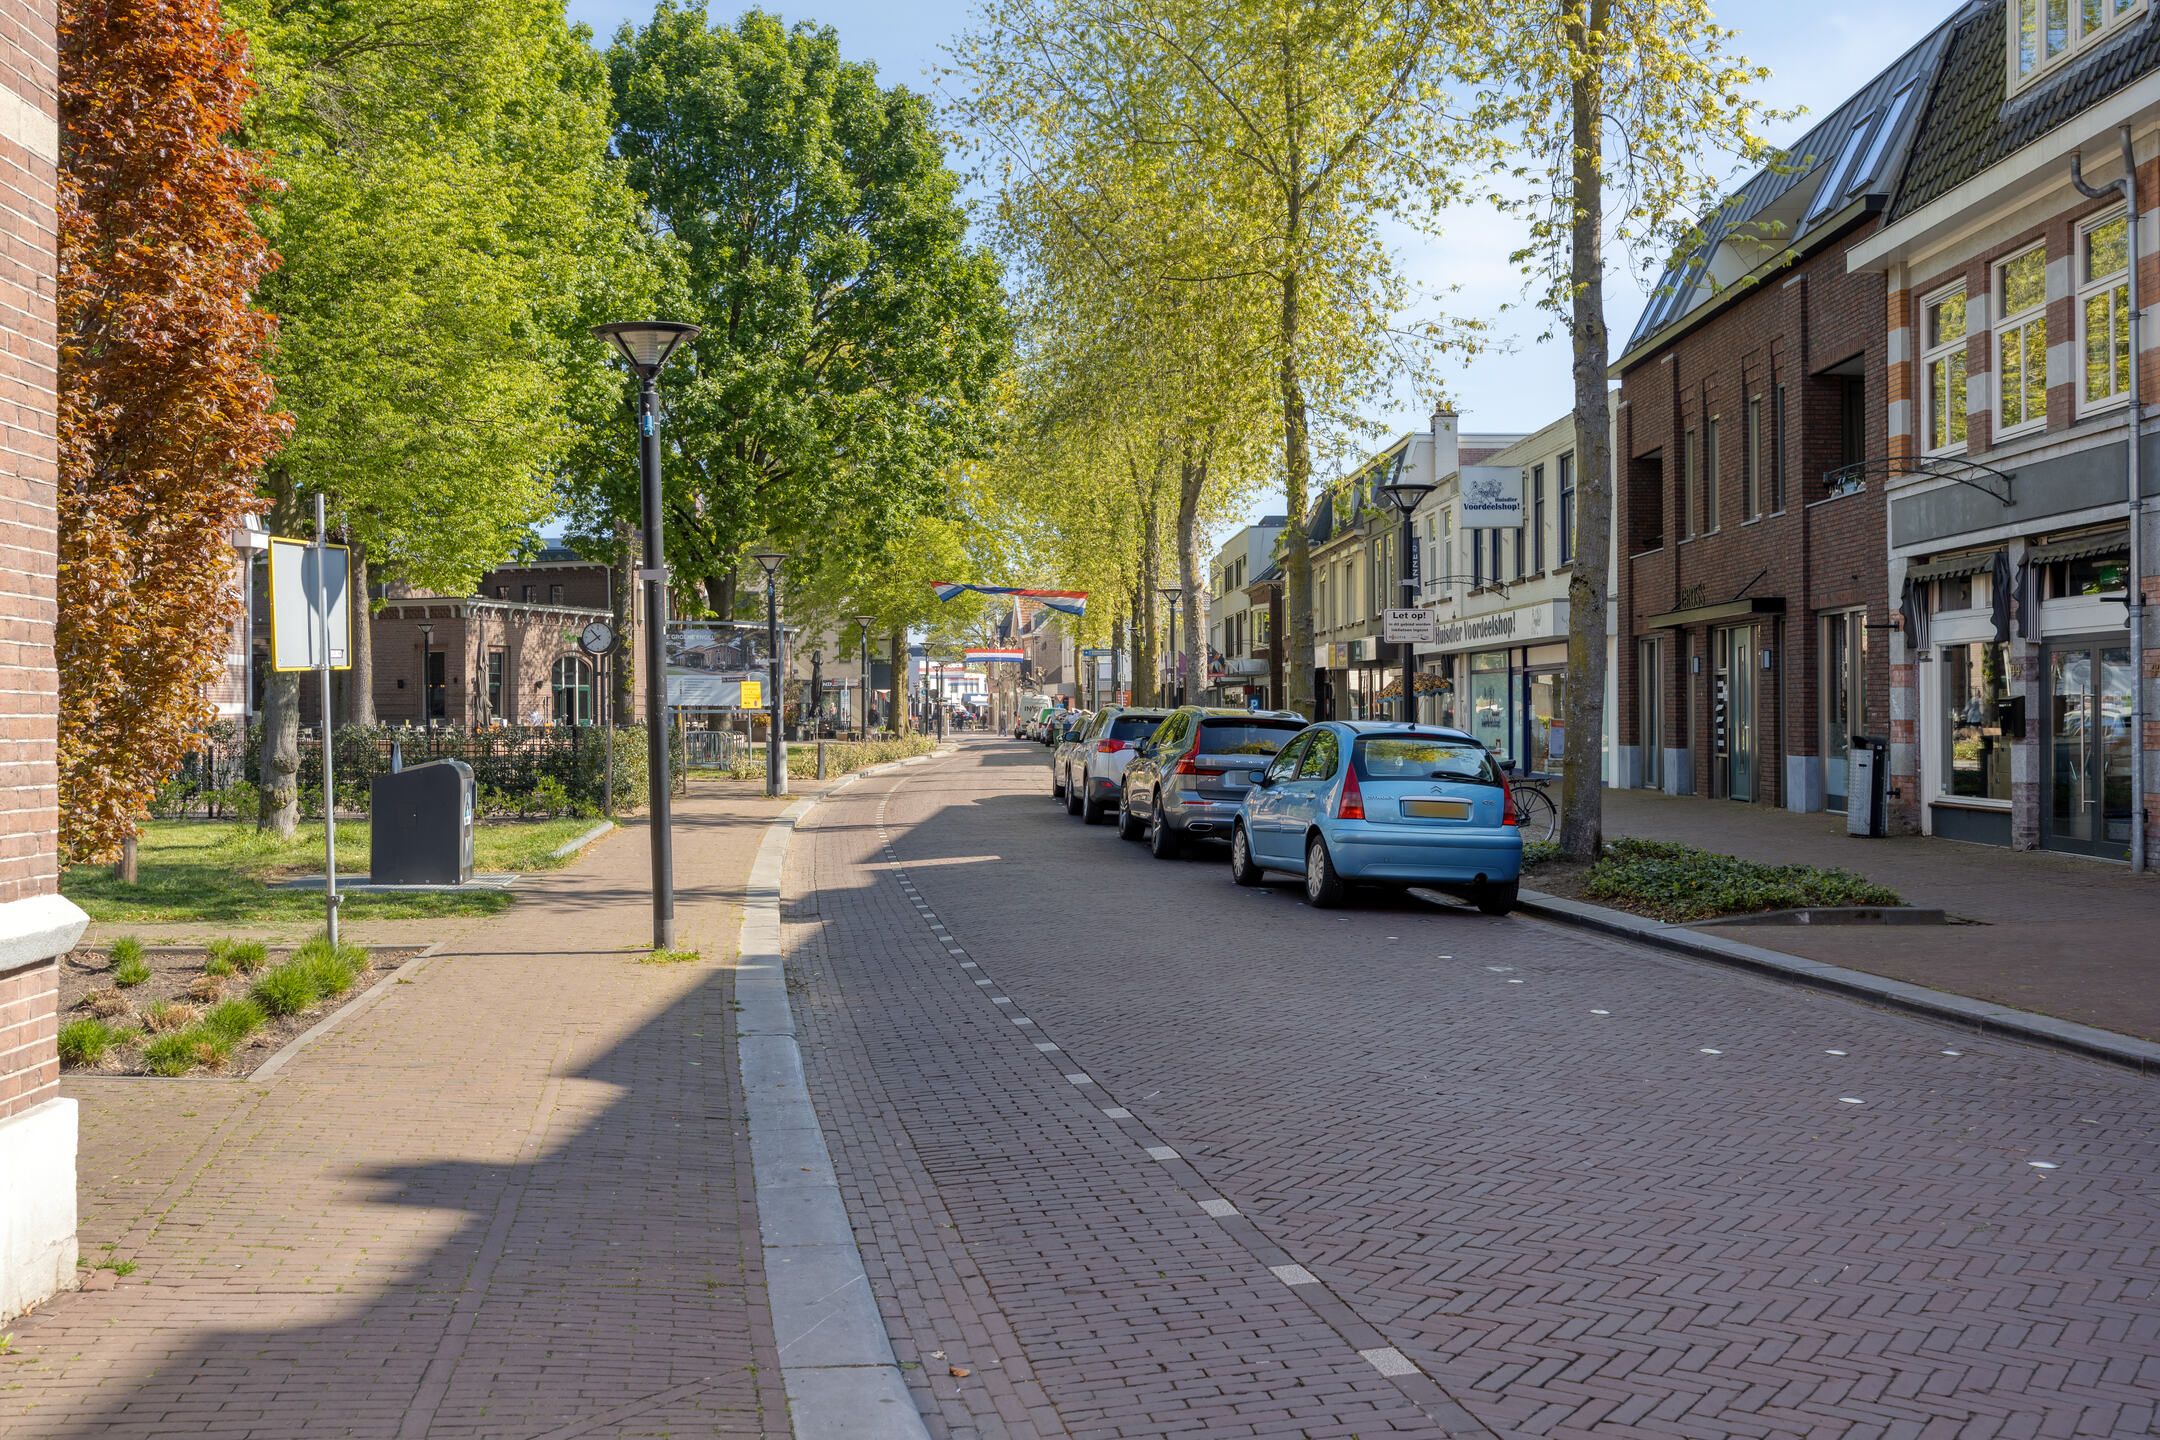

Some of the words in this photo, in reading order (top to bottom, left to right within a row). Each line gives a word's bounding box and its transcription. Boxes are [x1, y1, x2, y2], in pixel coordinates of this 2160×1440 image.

[1464, 503, 1520, 511] Voordeelshop!
[1411, 612, 1426, 620] op!
[1435, 621, 1462, 645] Huisdier
[1463, 611, 1516, 641] Voordeelshop!
